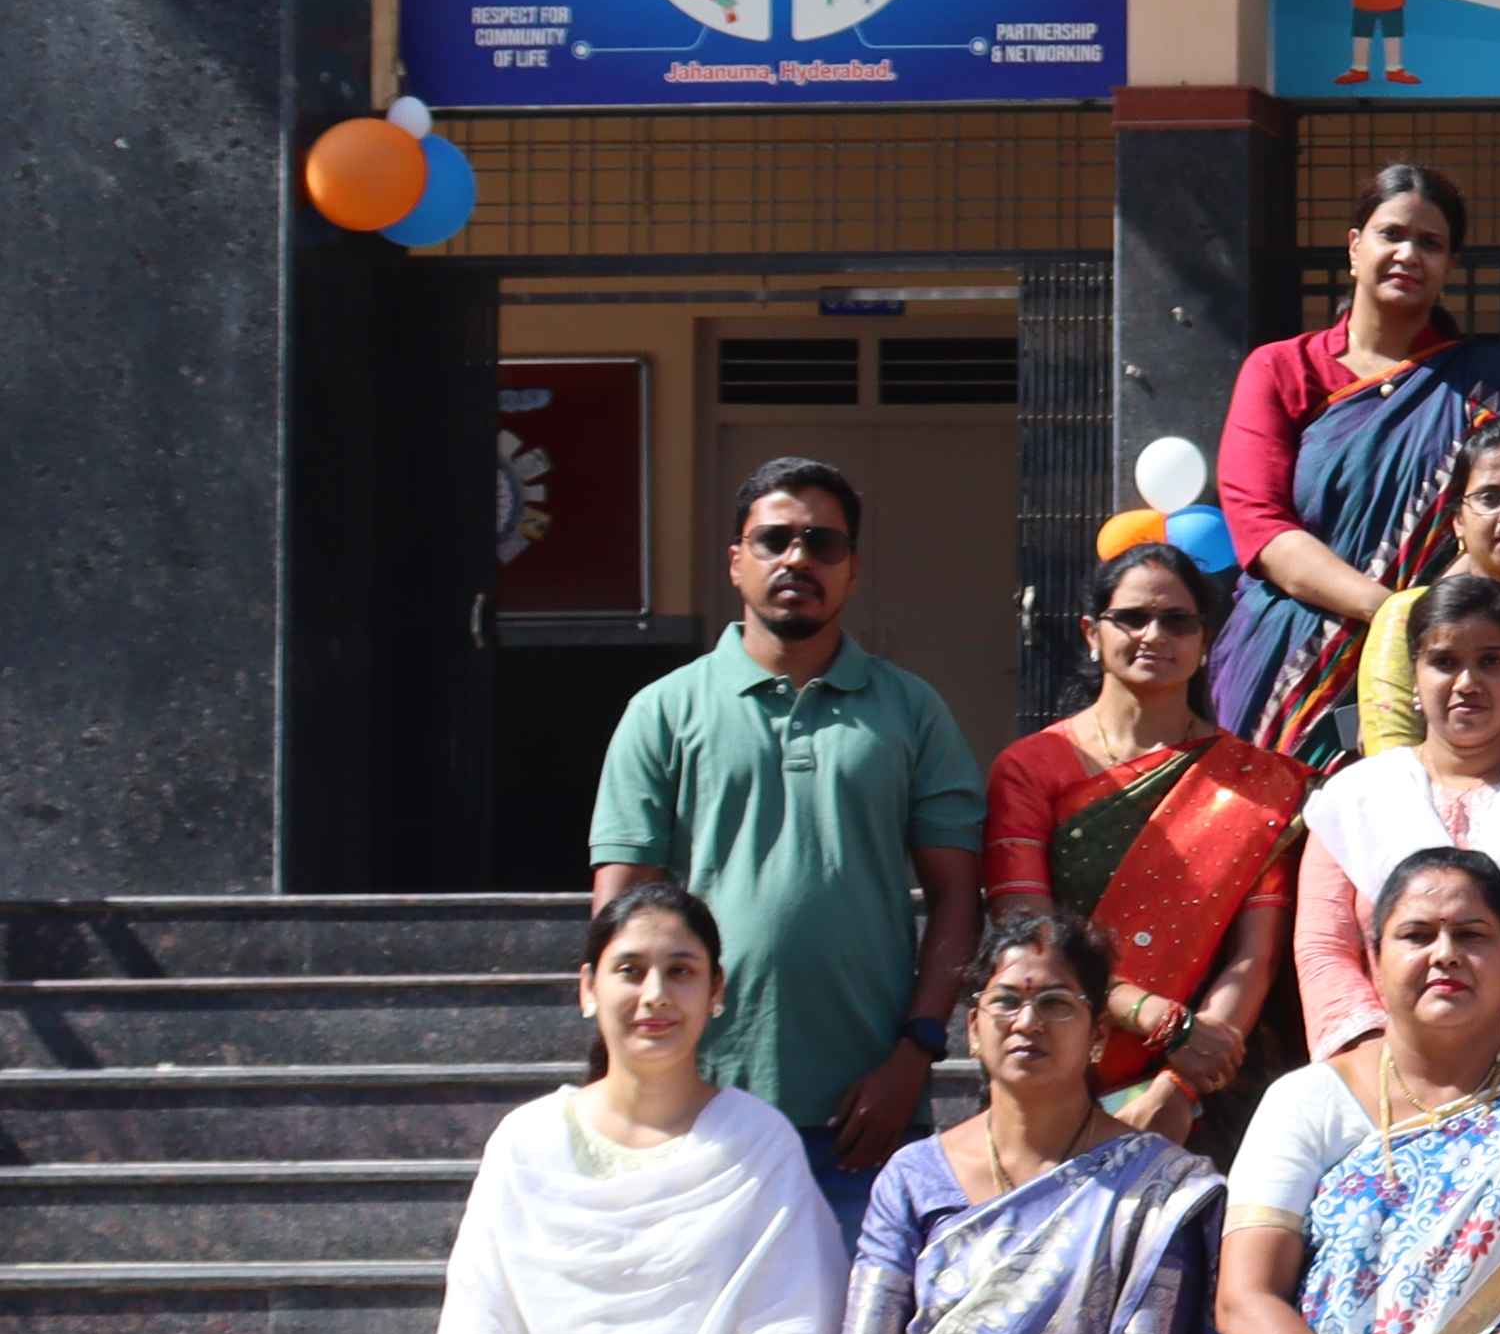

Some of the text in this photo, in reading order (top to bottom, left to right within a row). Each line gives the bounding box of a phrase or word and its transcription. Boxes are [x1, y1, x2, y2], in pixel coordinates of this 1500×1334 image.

[473, 8, 570, 24] RESPECT FOR
[476, 29, 565, 46] COMMUNITY
[997, 24, 1096, 42] PARTNERSHIP
[494, 50, 547, 67] OF LIFE
[992, 45, 1103, 63] & NETWORKING
